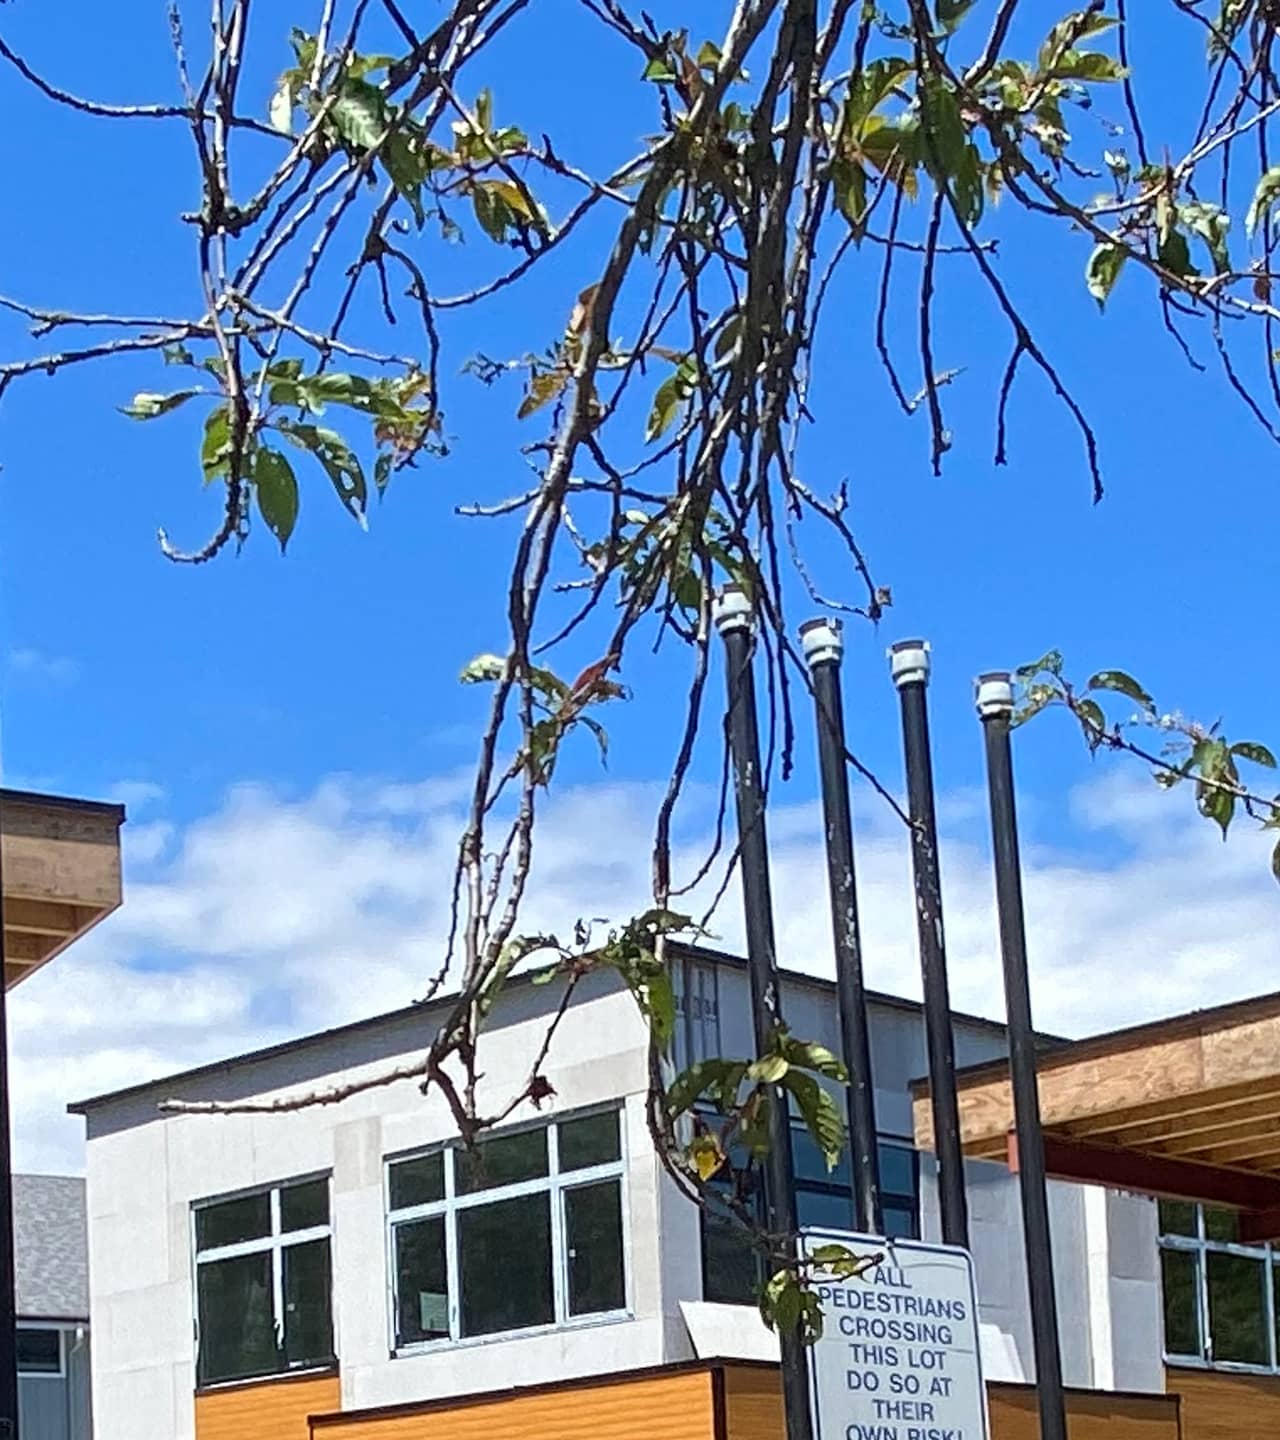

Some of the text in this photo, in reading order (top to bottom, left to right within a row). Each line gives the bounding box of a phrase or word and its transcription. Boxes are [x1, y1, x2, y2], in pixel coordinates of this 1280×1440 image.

[873, 1267, 912, 1289] ALL
[818, 1286, 966, 1321] PEDESTRIANS
[839, 1315, 952, 1345] CROSSING
[849, 1343, 946, 1370] THIS LOT
[847, 1370, 952, 1397] DO SO AT
[872, 1399, 934, 1422] THEIR
